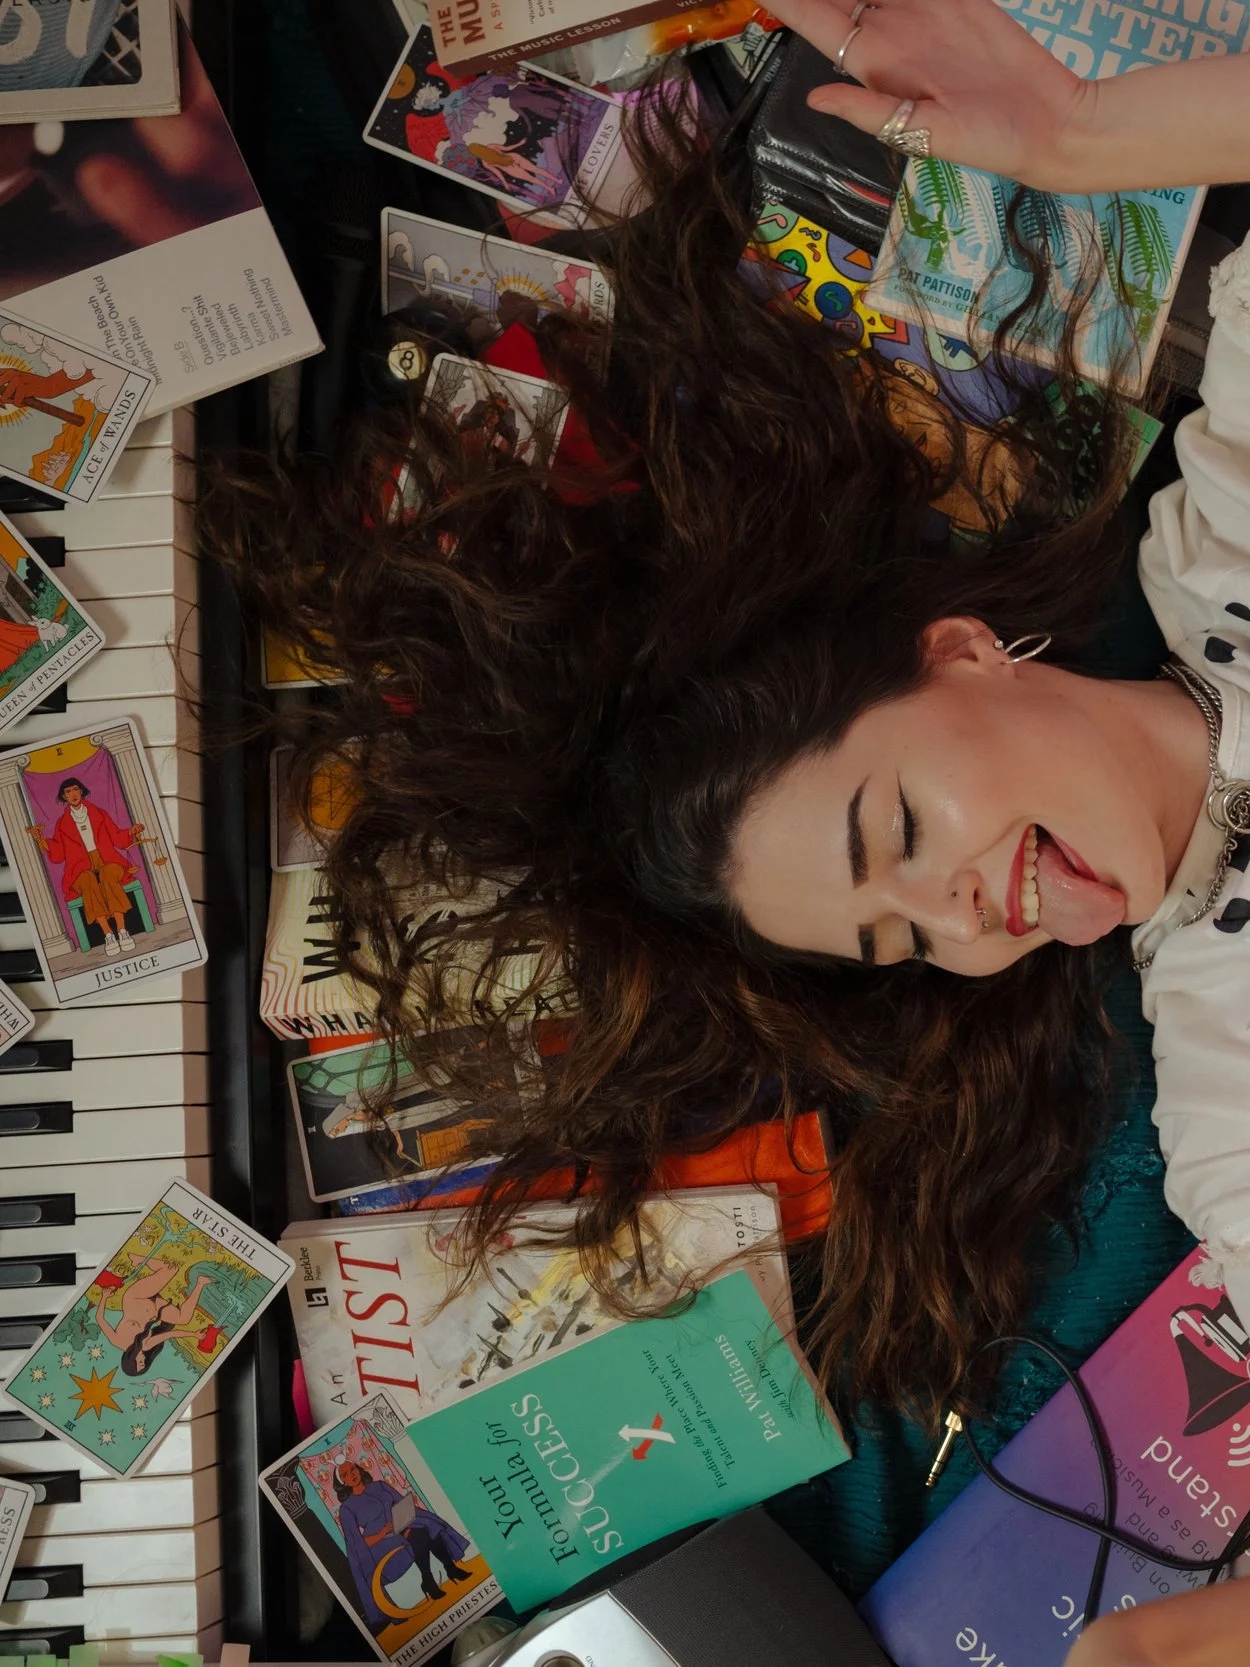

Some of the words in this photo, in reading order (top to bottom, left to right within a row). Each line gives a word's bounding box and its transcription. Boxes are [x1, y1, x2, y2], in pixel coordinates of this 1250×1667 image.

[437, 7, 457, 48] THE
[488, 48, 519, 62] THE
[520, 34, 564, 53] MUSIC
[567, 17, 621, 38] LESSON
[494, 22, 504, 31] A
[586, 123, 614, 173] LOVERS
[93, 275, 109, 294] Kid
[243, 268, 265, 309] Nothing
[898, 268, 920, 288] PAT
[922, 275, 979, 304] PATTISON
[88, 295, 109, 330] Beach
[192, 294, 208, 316] Shit
[260, 276, 293, 337] Mastermind
[115, 317, 129, 344] Your
[128, 316, 142, 341] Rain
[210, 302, 241, 357] Bejeweled
[228, 303, 254, 351] Labyrinth
[247, 312, 267, 346] Karma
[262, 305, 280, 341] Sweet
[103, 328, 115, 351] The
[124, 341, 136, 360] On
[174, 340, 184, 351] B
[203, 316, 227, 362] Vigilante
[180, 350, 195, 375] Side
[400, 350, 414, 370] 8
[103, 390, 136, 439] WANDS
[99, 441, 108, 454] of
[83, 454, 104, 484] ACE
[0, 690, 28, 718] UEEN
[29, 681, 37, 692] of
[36, 631, 94, 685] PENTACLES
[95, 955, 161, 987] JUSTICE
[192, 1207, 229, 1238] STAR
[733, 1207, 746, 1248] TOSTI
[231, 1234, 256, 1261] THE
[300, 1247, 314, 1282] Berklee
[642, 1349, 660, 1375] Your
[666, 1353, 685, 1381] Meet
[715, 1334, 763, 1412] Williams
[658, 1374, 679, 1408] Where
[682, 1380, 707, 1418] Passion
[768, 1379, 786, 1400] Jim
[678, 1408, 697, 1435] Place
[777, 1400, 795, 1419] with
[485, 1422, 522, 1447] for
[693, 1435, 706, 1447] the
[702, 1418, 718, 1434] and
[758, 1411, 781, 1442] Pat
[714, 1435, 736, 1470] Talent
[510, 1393, 624, 1554] SUCCESS
[702, 1448, 728, 1489] Finding
[479, 1475, 524, 1540] Your
[507, 1452, 580, 1565] Formula
[1158, 1505, 1171, 1519] a
[1125, 1512, 1159, 1543] and
[1171, 1519, 1191, 1541] as
[1149, 1571, 1171, 1594] on
[395, 1643, 418, 1666] THE
[418, 1620, 448, 1647] HIGH
[449, 1580, 501, 1624] PRIESTES
